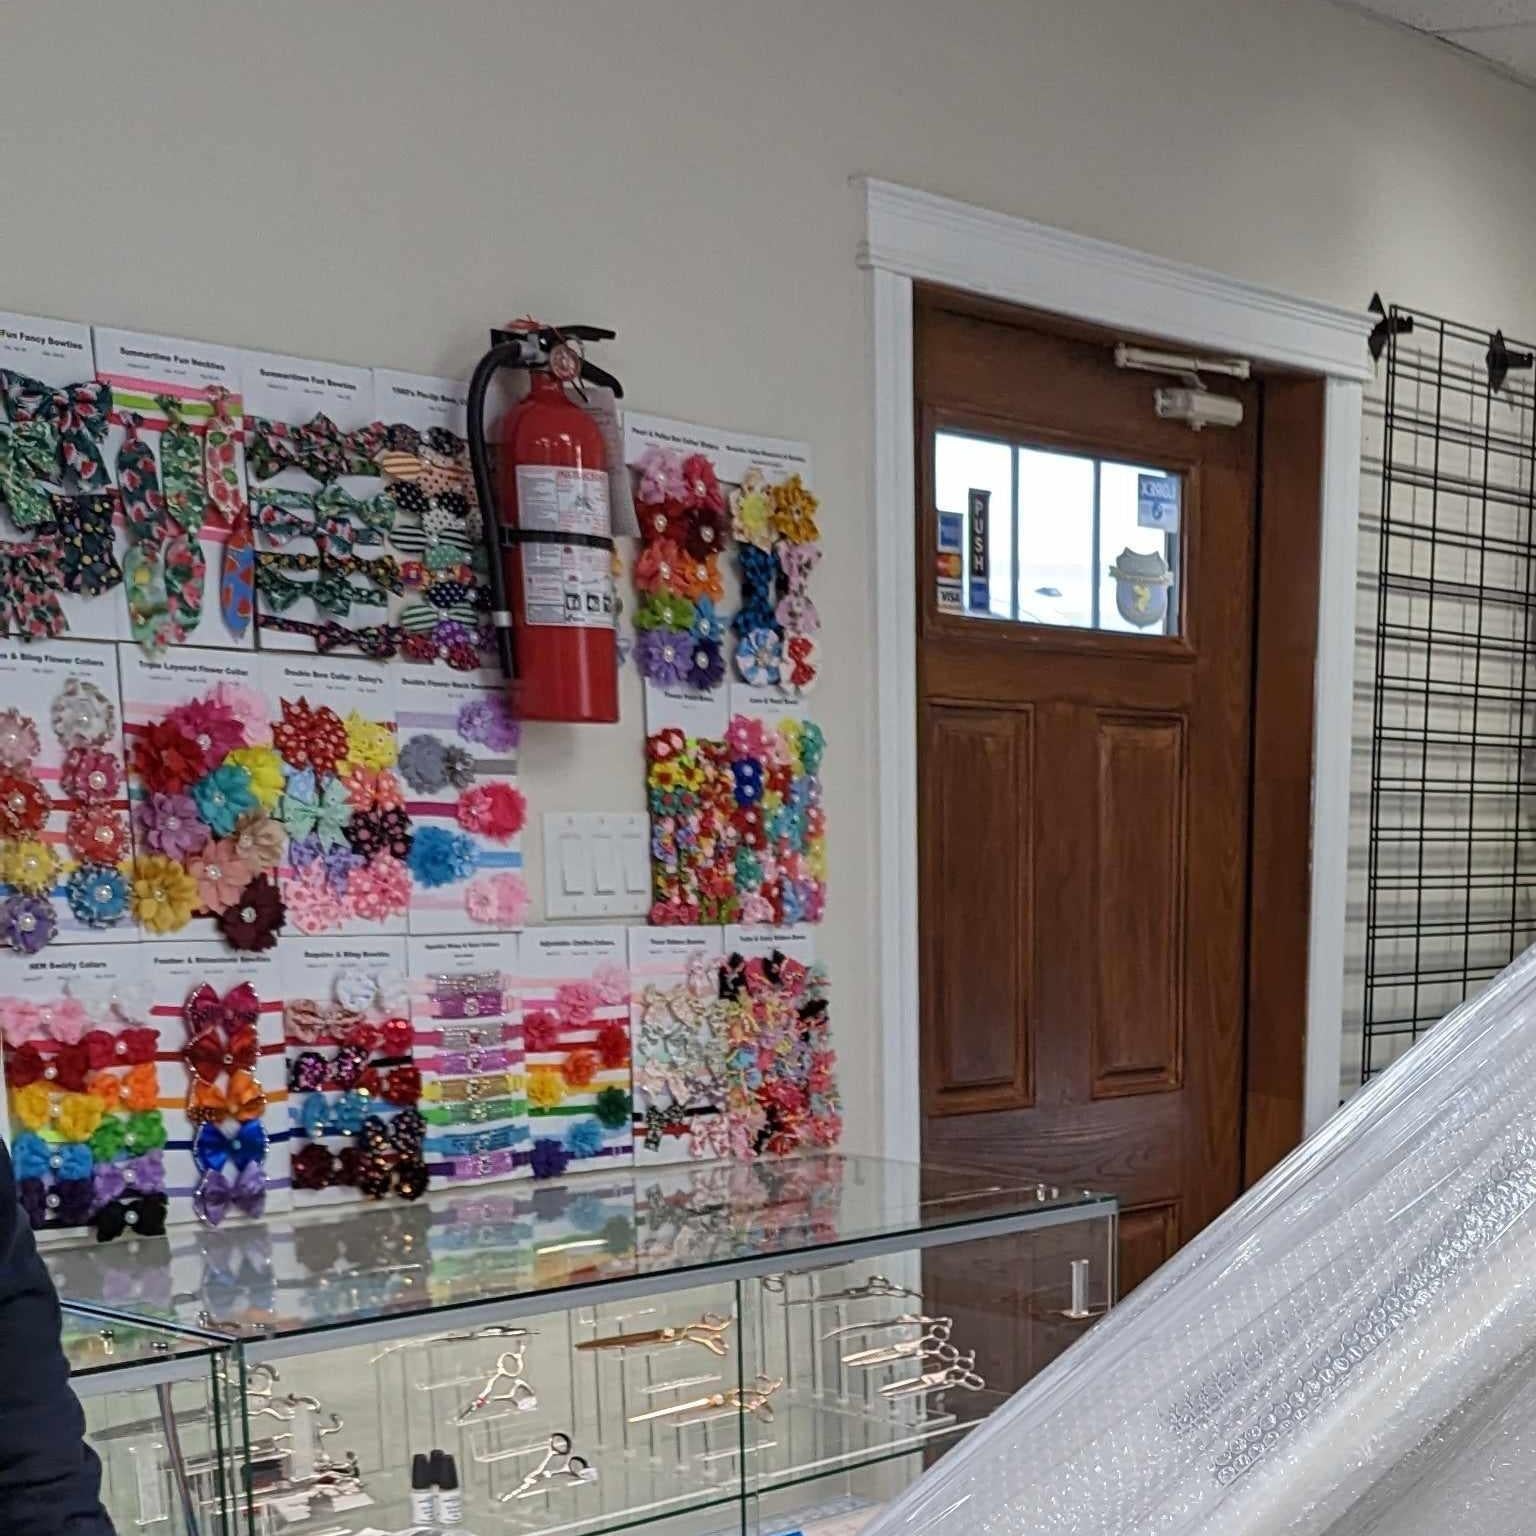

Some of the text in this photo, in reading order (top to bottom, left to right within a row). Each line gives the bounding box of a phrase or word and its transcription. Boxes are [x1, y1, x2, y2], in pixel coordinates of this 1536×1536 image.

[19, 332, 45, 345] Fancy
[48, 336, 83, 350] Bowties
[120, 347, 171, 362] Summertime
[174, 355, 189, 365] Fun
[260, 368, 357, 390] Summertime Fun Bowties
[974, 499, 984, 572] PUSH
[941, 591, 960, 601] VISA
[20, 653, 42, 663] Bling
[44, 655, 72, 663] Flower
[75, 657, 104, 666] Collars
[164, 662, 197, 672] Layered
[198, 666, 223, 674] Flower
[225, 667, 248, 676] Collar
